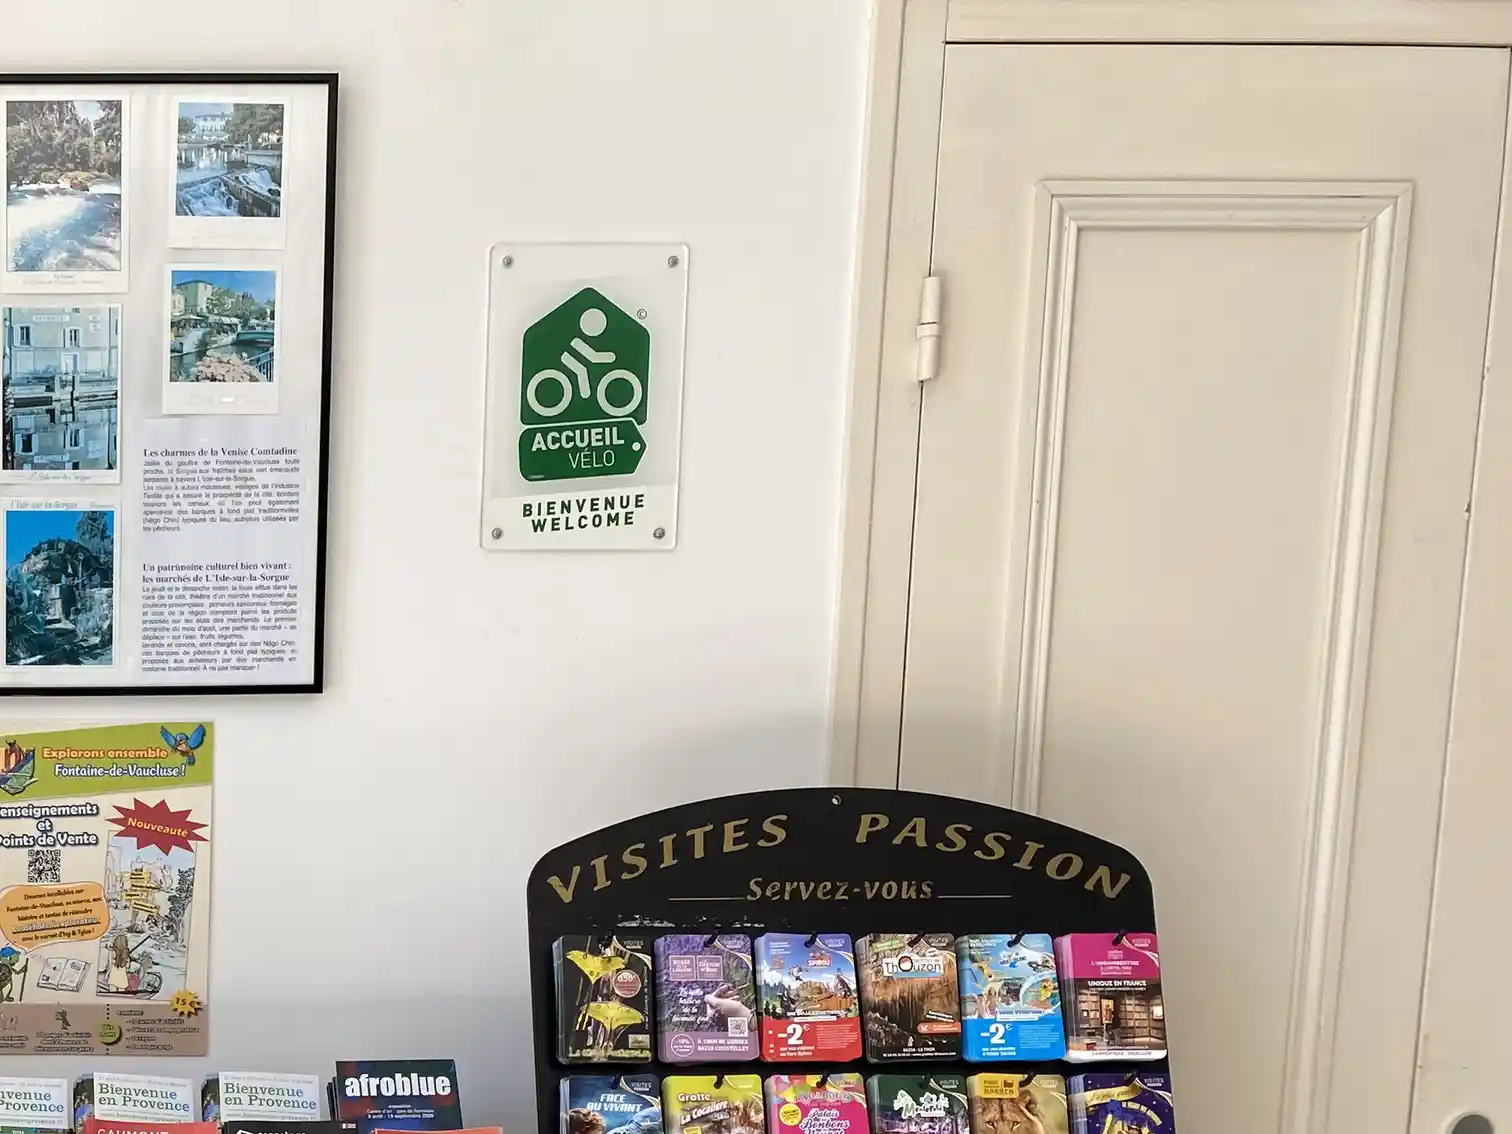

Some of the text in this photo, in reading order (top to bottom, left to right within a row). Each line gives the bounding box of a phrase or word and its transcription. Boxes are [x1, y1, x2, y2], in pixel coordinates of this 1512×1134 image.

[531, 427, 625, 452] ACCUEIL
[143, 447, 297, 457] Les charmes de la Venise Comtadine
[568, 448, 615, 469] VÉLO
[522, 493, 646, 518] BIENVENUE
[531, 511, 635, 533] WELCOME
[142, 573, 289, 584] les marchés de L'Isle-sur-la-Sorgue
[42, 747, 168, 760] Explorons ensemble
[36, 820, 52, 831] et
[127, 818, 188, 838] Nouveauté
[37, 834, 54, 845] de
[57, 833, 98, 845] Vente
[546, 813, 1131, 905] VISITES PASSION
[746, 877, 934, 902] Servez-vous
[98, 1083, 177, 1099] Bienvenue
[224, 1083, 303, 1097] Bienvenue
[345, 1073, 451, 1097] afroblue
[600, 1094, 625, 1103] FACE
[678, 1093, 710, 1102] Grotte
[800, 1119, 850, 1130] Bonbons
